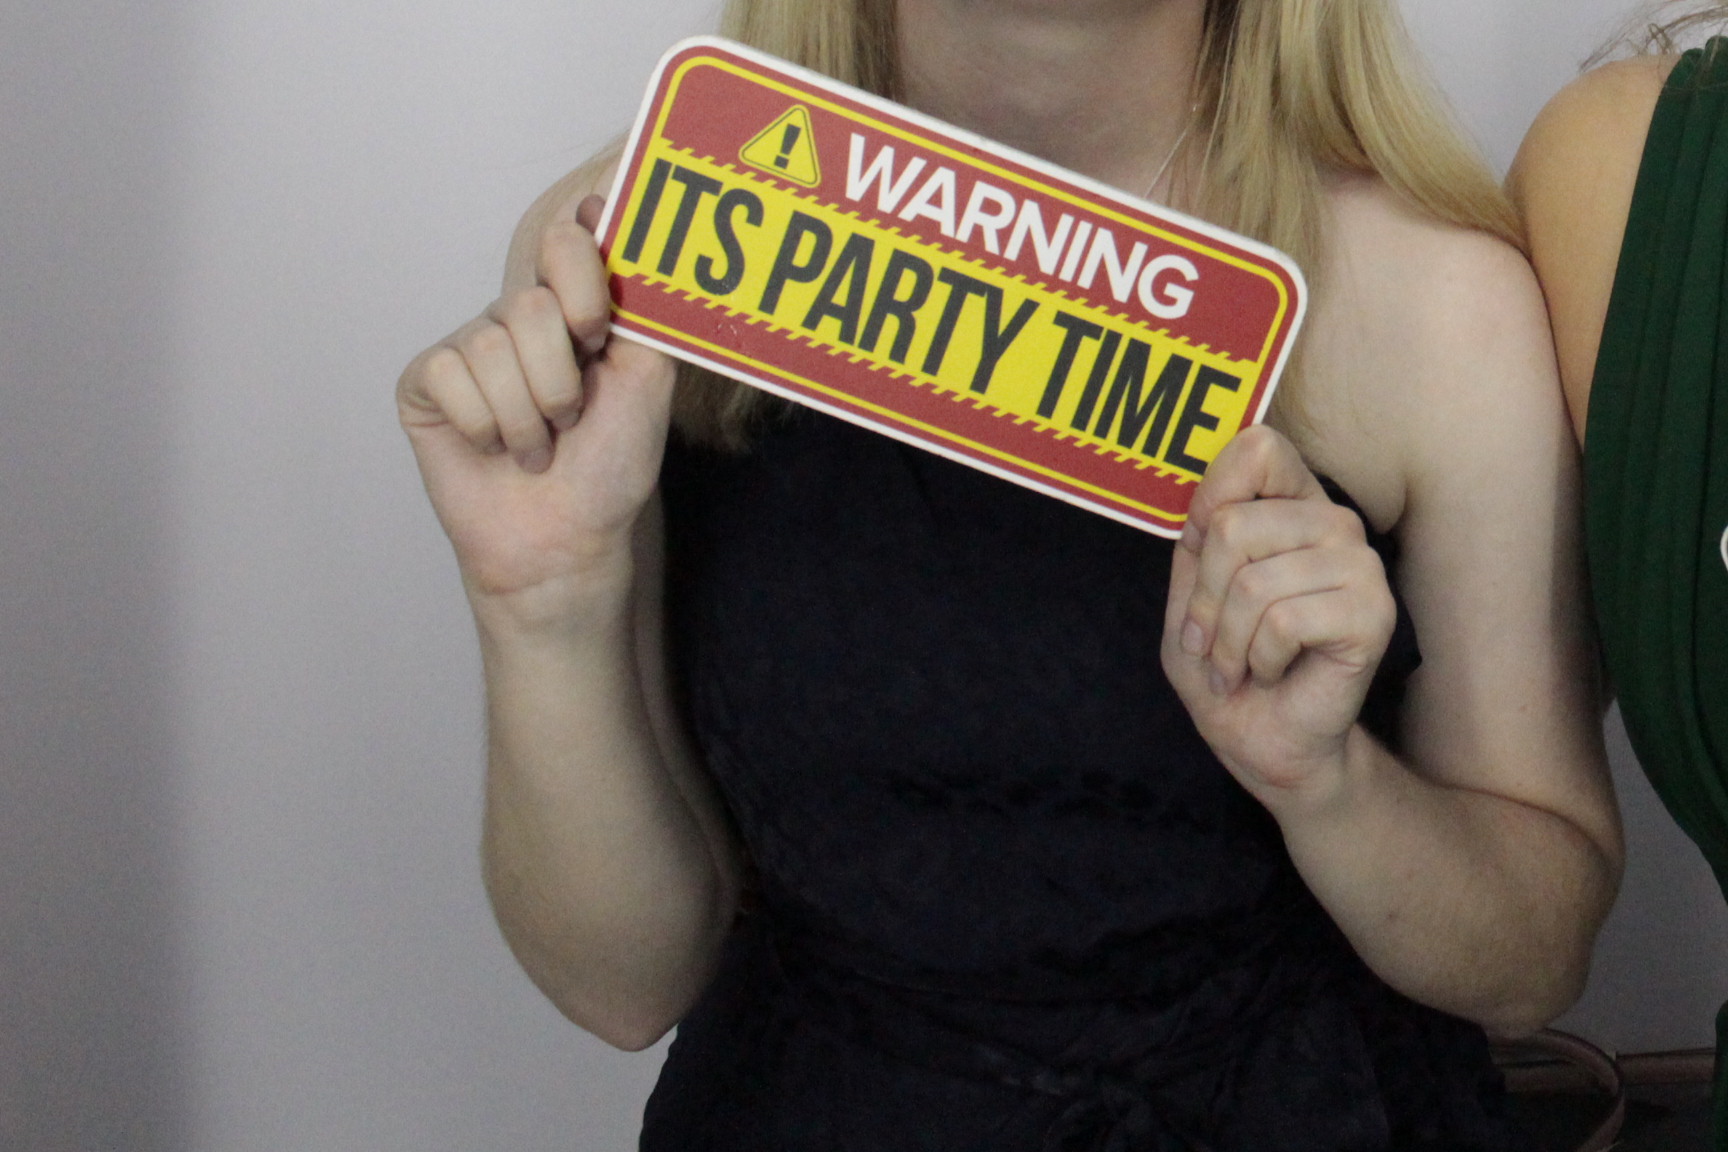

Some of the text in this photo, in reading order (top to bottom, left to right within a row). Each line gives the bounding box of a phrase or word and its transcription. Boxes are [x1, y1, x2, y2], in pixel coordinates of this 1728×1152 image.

[620, 156, 1242, 476] ITS PARTY TIME
[844, 132, 1199, 320] WARNING
